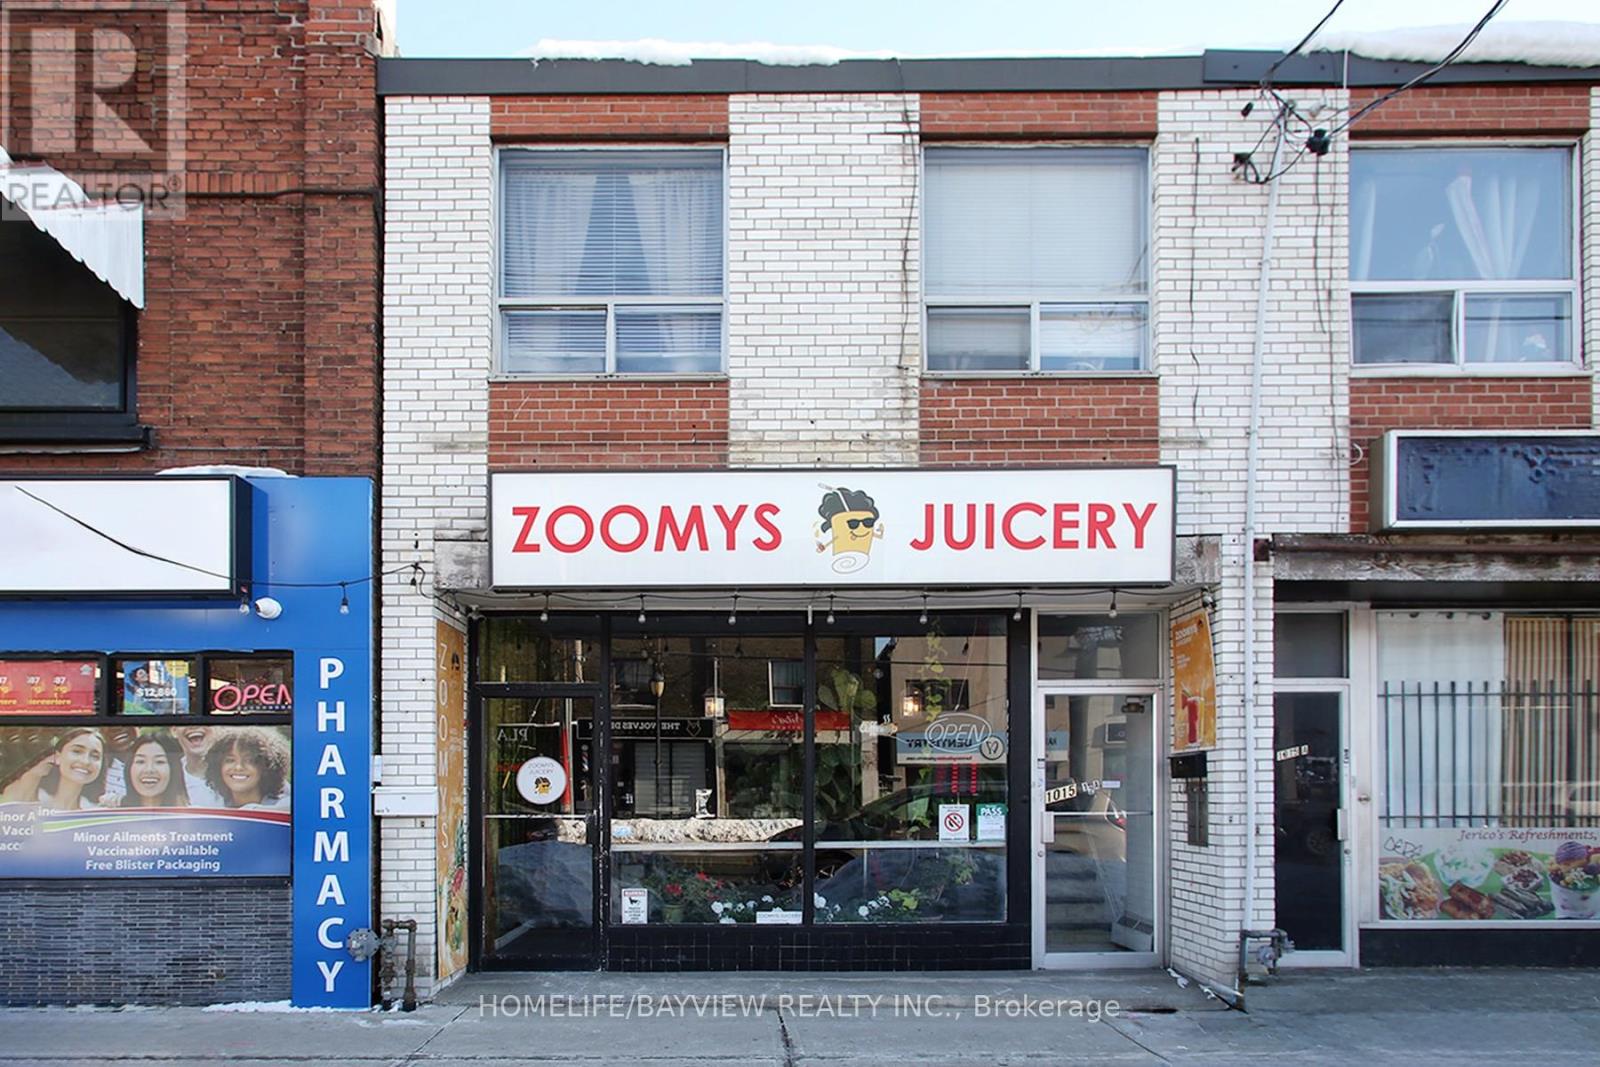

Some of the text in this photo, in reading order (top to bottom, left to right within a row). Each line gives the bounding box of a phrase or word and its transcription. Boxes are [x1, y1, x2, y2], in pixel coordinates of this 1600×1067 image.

[511, 502, 1158, 553] ZOOMYS JUICERY
[214, 684, 292, 710] OPEN
[928, 723, 986, 743] OPEN
[438, 642, 449, 849] ZOOMYS
[1046, 785, 1077, 803] 1015
[981, 807, 1003, 817] PASS
[313, 657, 350, 992] PHARMACY
[73, 832, 234, 842] Minor Ailments Treatment
[1458, 829, 1598, 843] Jerico's Refreshments,
[88, 845, 220, 856] Vaccination Available
[86, 859, 220, 872] Free Blister Packaging
